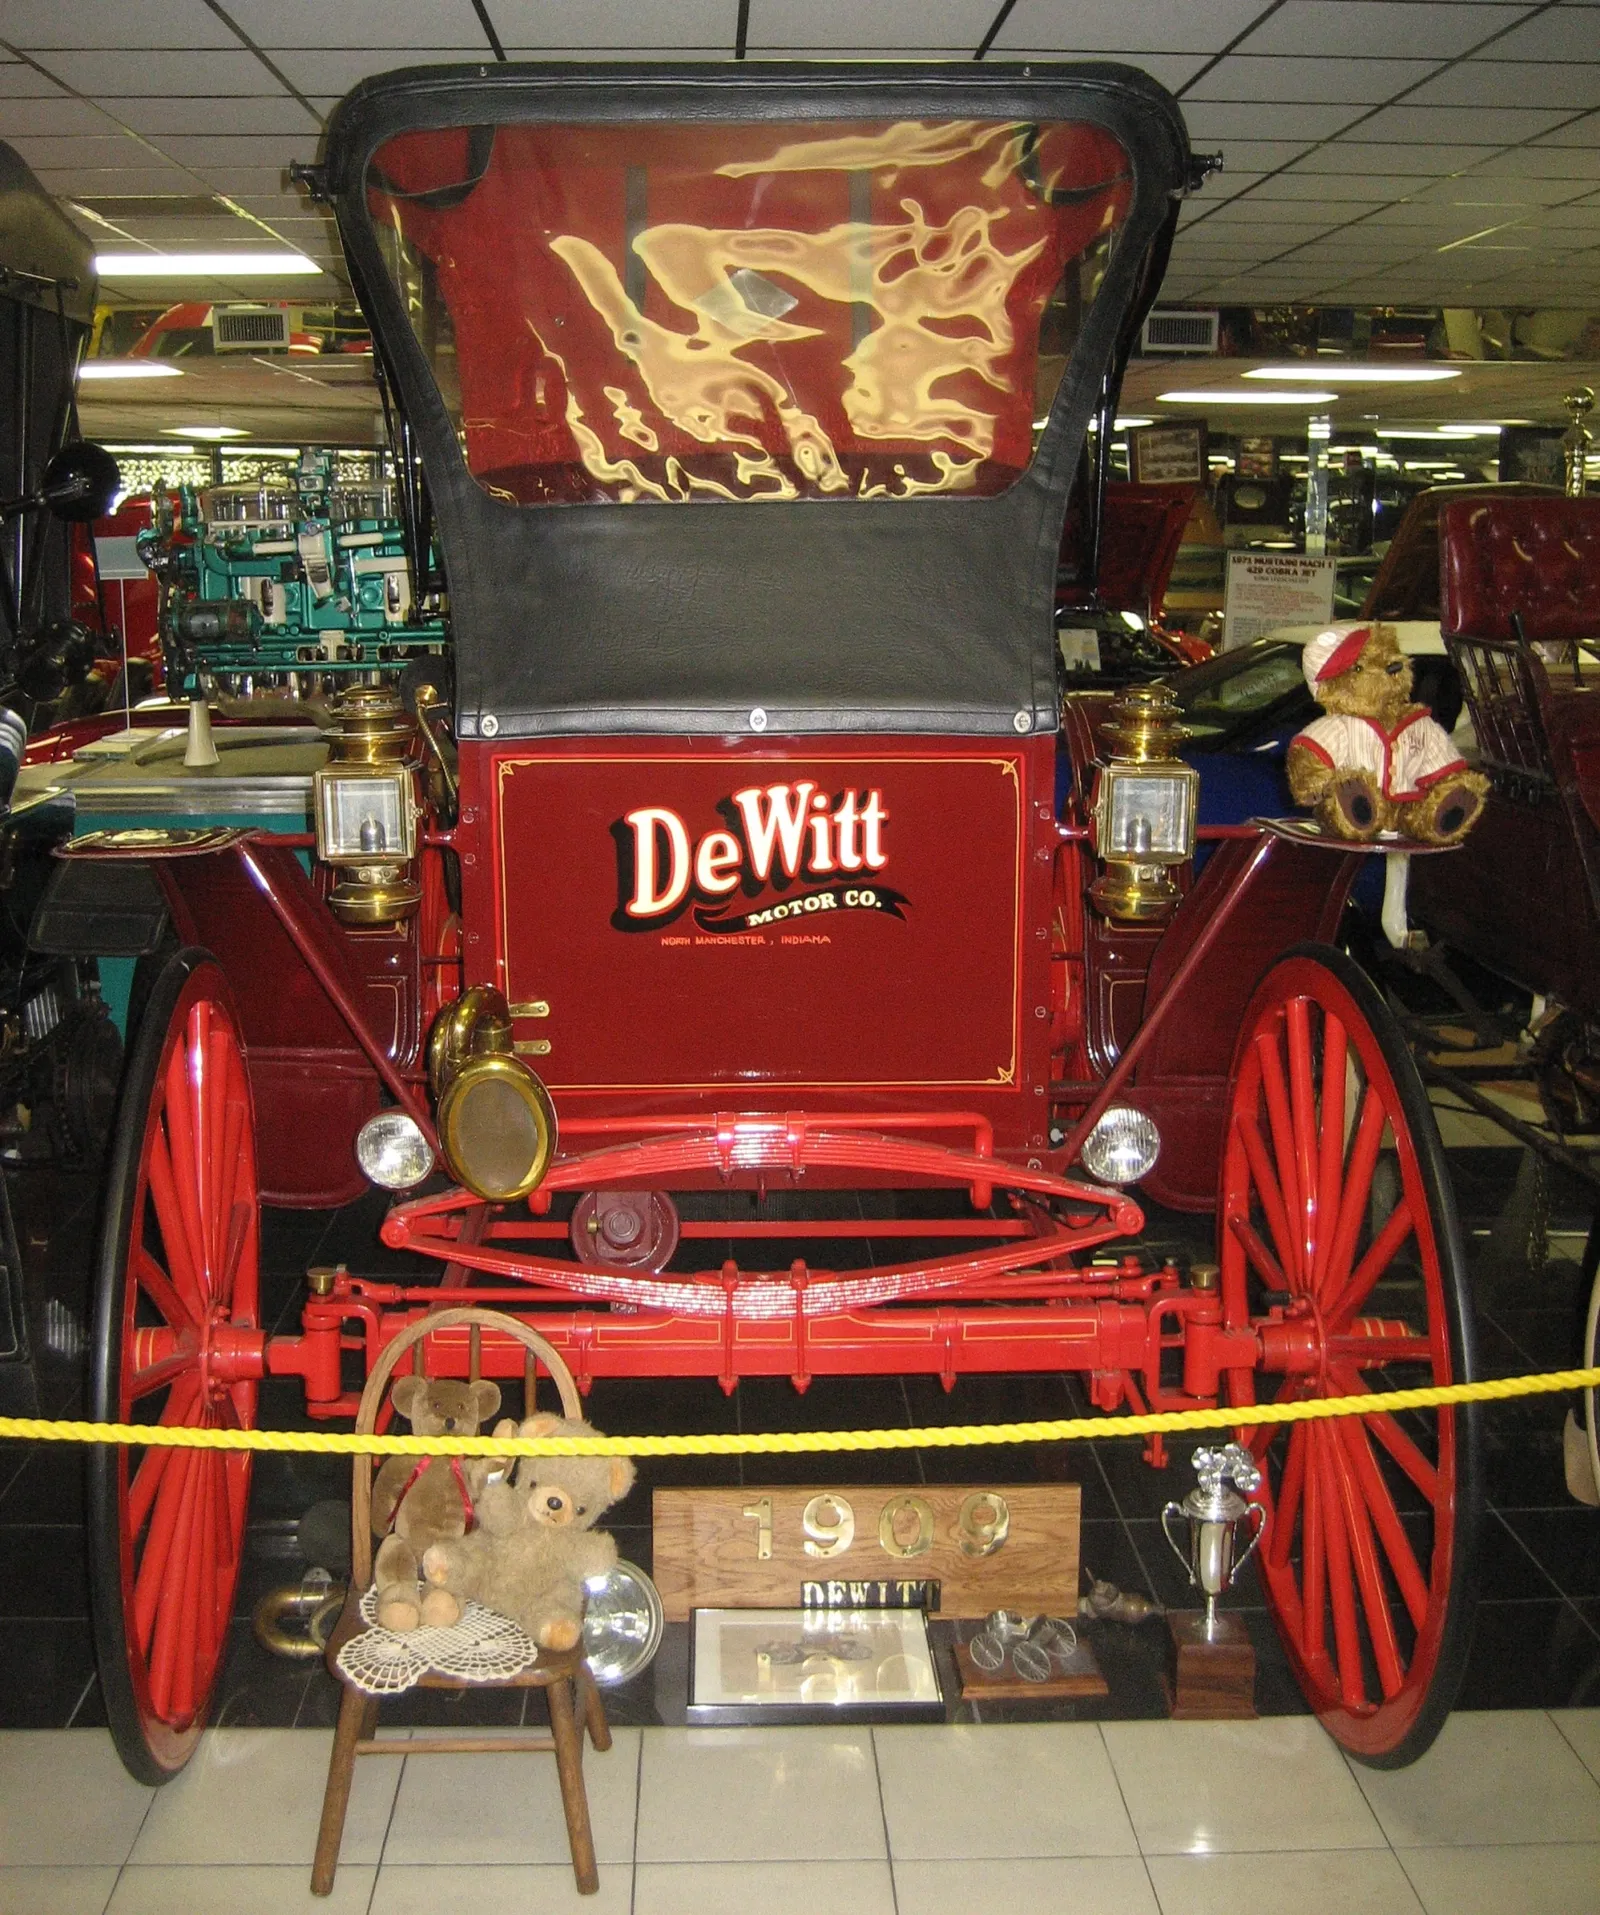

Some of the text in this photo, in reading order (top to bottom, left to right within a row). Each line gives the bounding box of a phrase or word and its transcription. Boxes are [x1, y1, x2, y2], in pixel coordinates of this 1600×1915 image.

[624, 780, 889, 918] DeWitt
[747, 890, 882, 927] MOTOR CO.
[661, 936, 691, 946] NORTH
[781, 935, 831, 945] INDIANA
[742, 1491, 1010, 1560] 1909
[802, 1580, 940, 1609] DEWITT
